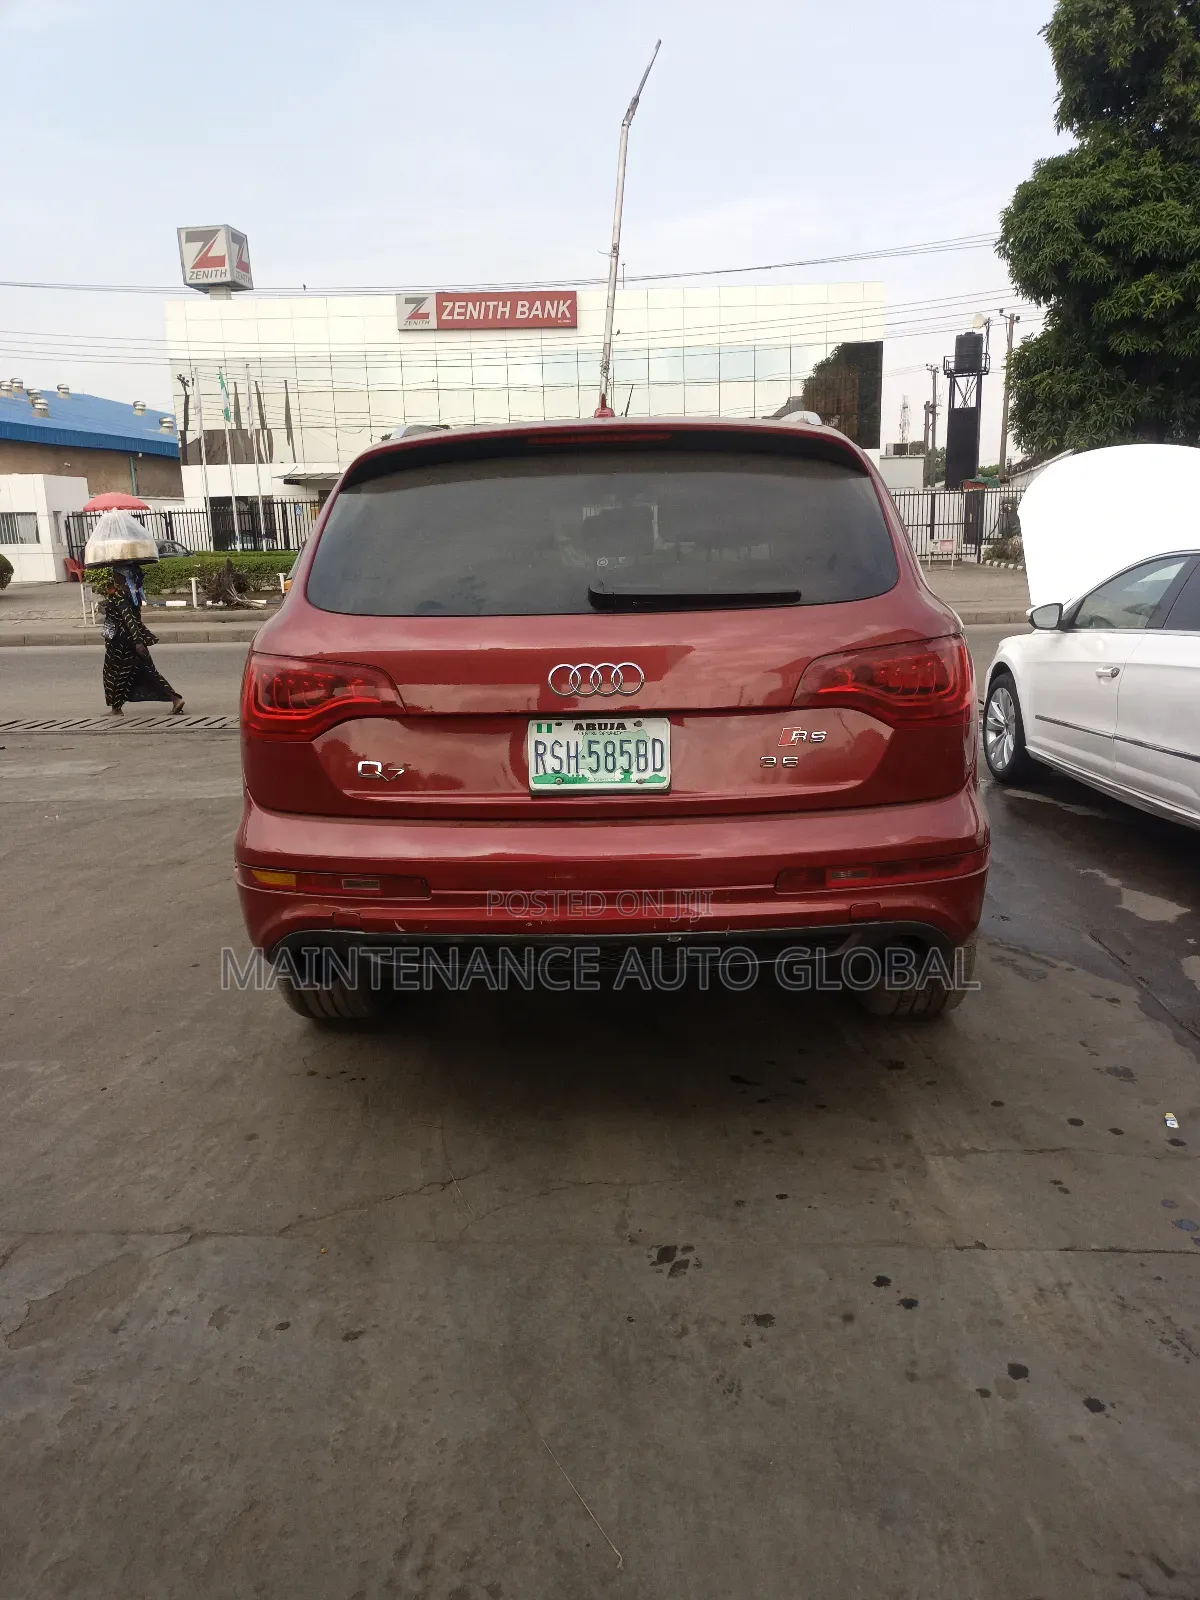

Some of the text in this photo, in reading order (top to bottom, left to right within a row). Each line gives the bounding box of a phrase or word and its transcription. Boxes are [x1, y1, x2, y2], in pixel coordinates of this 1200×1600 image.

[189, 269, 227, 280] ZENITH
[441, 299, 573, 320] ZENITH BANK
[573, 722, 627, 731] ABUJA
[790, 730, 827, 743] RS
[357, 760, 405, 782] Q7
